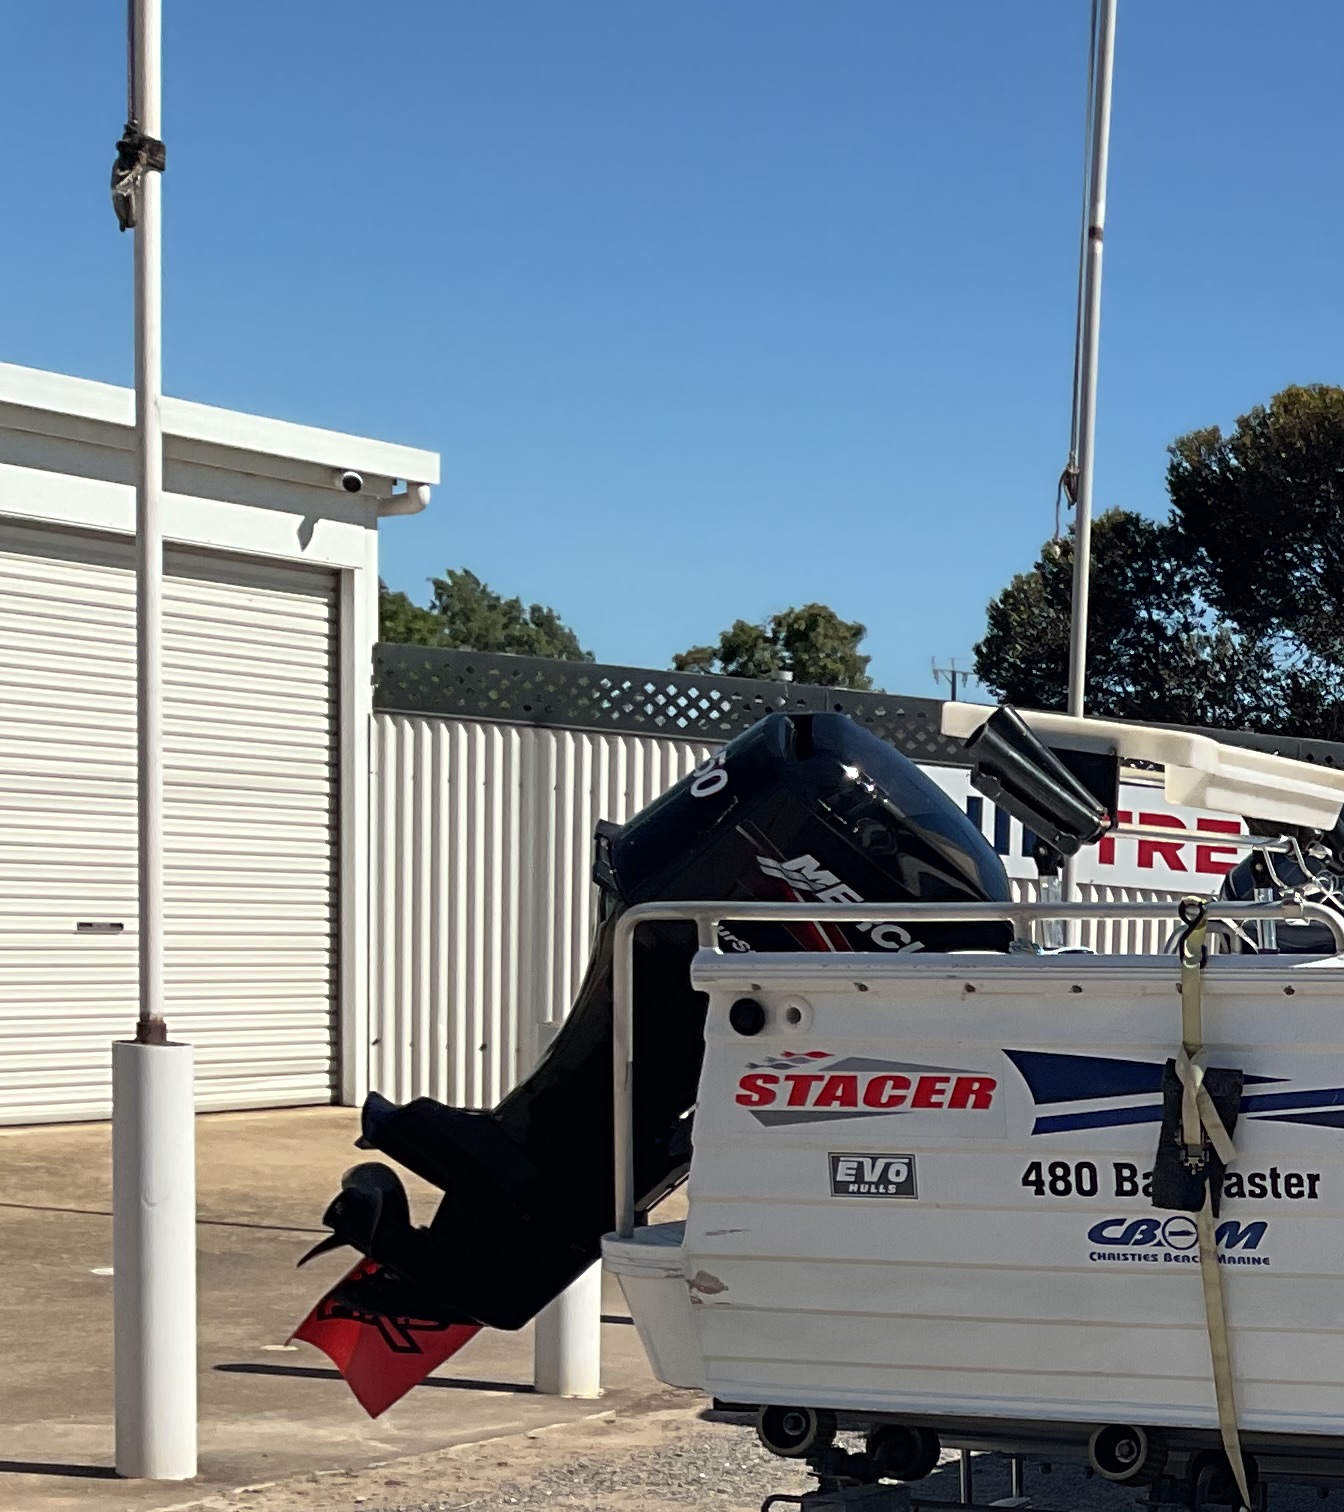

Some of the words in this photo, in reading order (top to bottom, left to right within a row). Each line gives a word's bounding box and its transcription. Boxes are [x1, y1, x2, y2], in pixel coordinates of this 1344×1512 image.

[735, 1073, 998, 1110] STACER
[836, 1156, 909, 1183] EVO
[1021, 1161, 1099, 1198] 480
[848, 1183, 897, 1194] HULLS
[1163, 1253, 1201, 1264] BEAC
